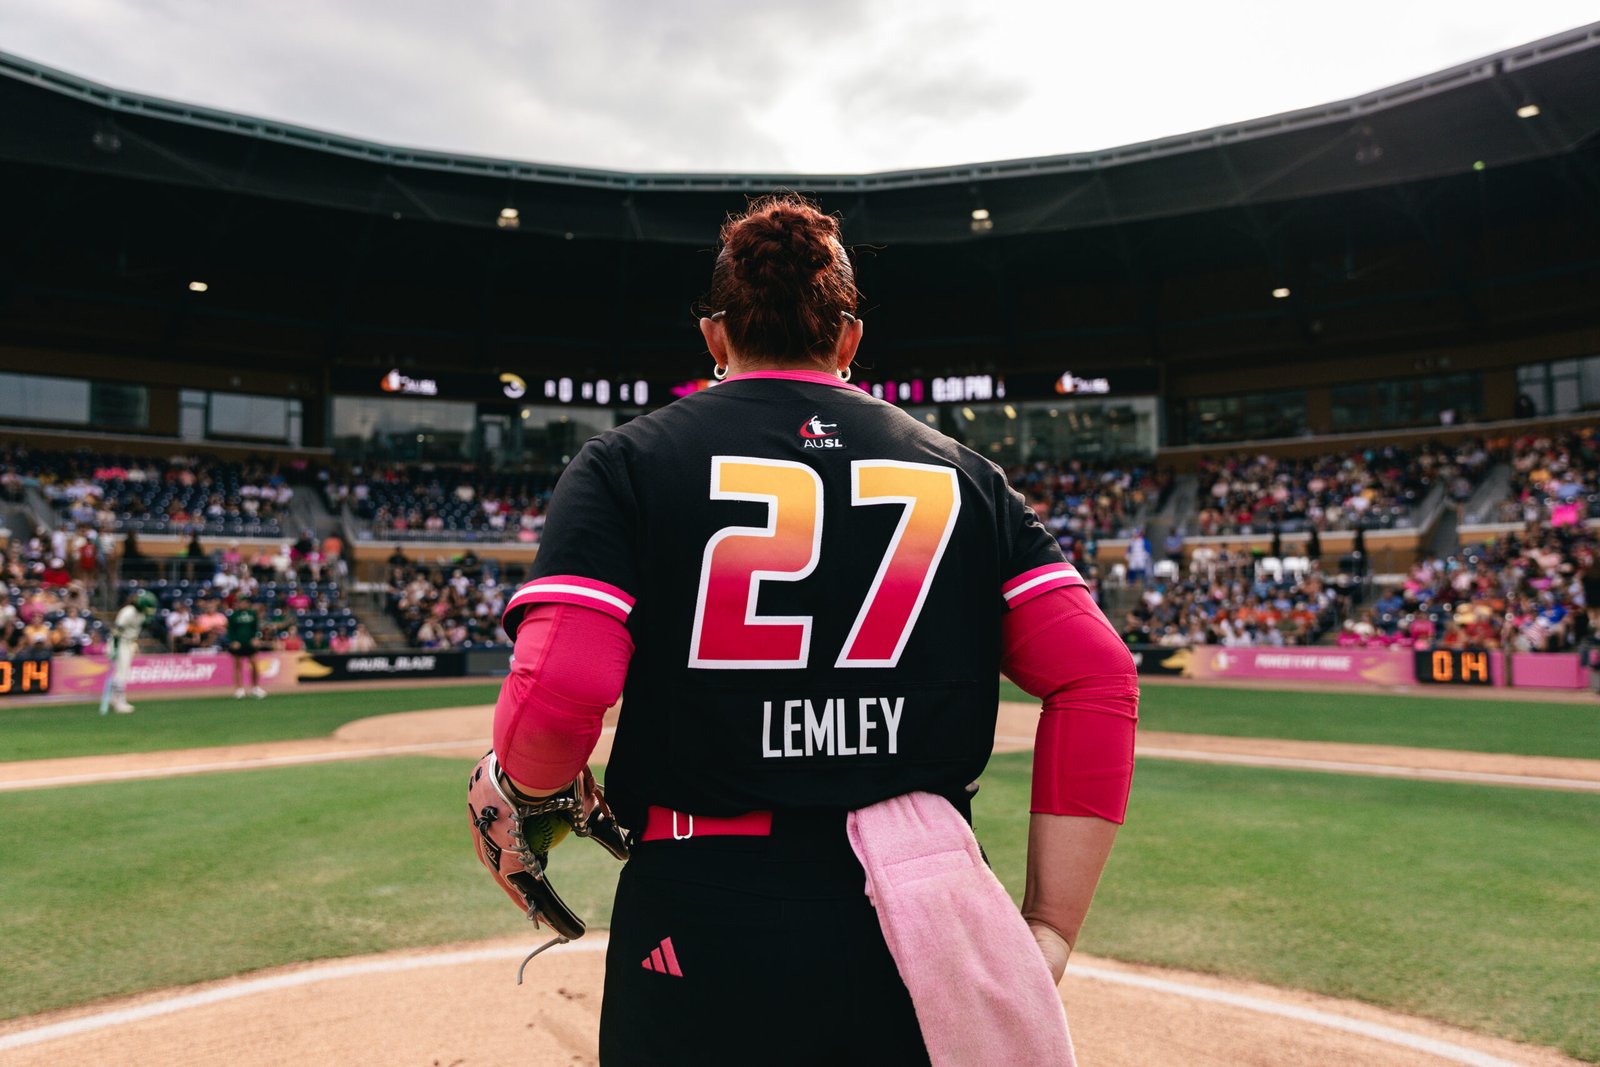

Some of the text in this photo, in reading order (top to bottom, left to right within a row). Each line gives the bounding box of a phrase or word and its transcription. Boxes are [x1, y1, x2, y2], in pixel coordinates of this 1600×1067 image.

[803, 438, 844, 449] AUSL
[687, 455, 962, 669] 27
[126, 662, 217, 684] EGENDARY
[762, 696, 905, 758] LEMLEY
